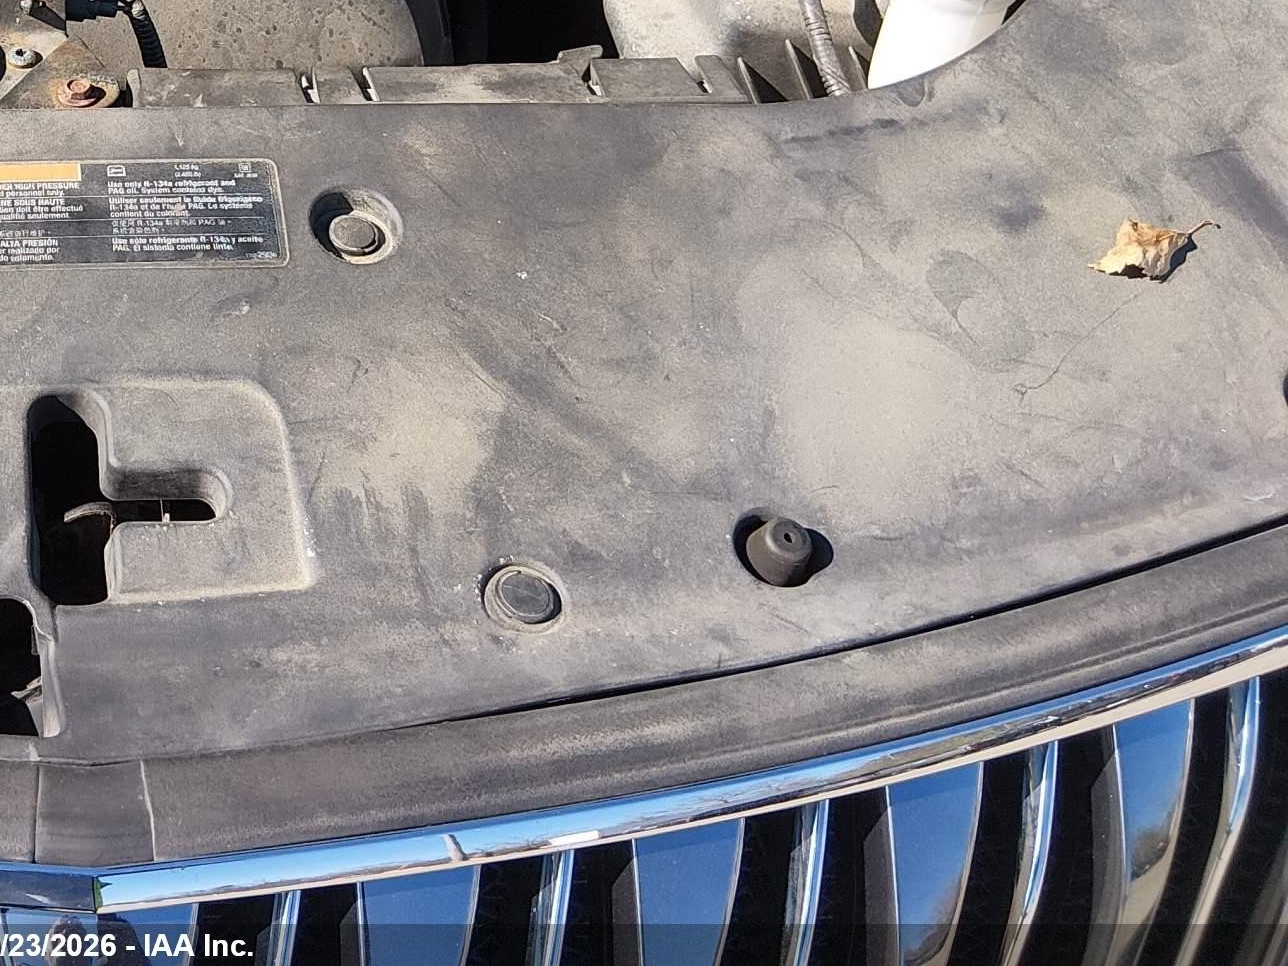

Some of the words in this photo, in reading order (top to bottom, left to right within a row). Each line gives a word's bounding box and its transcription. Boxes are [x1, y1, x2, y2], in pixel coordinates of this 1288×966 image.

[125, 181, 142, 189] only
[0, 240, 22, 248] ALTA
[46, 247, 61, 255] por
